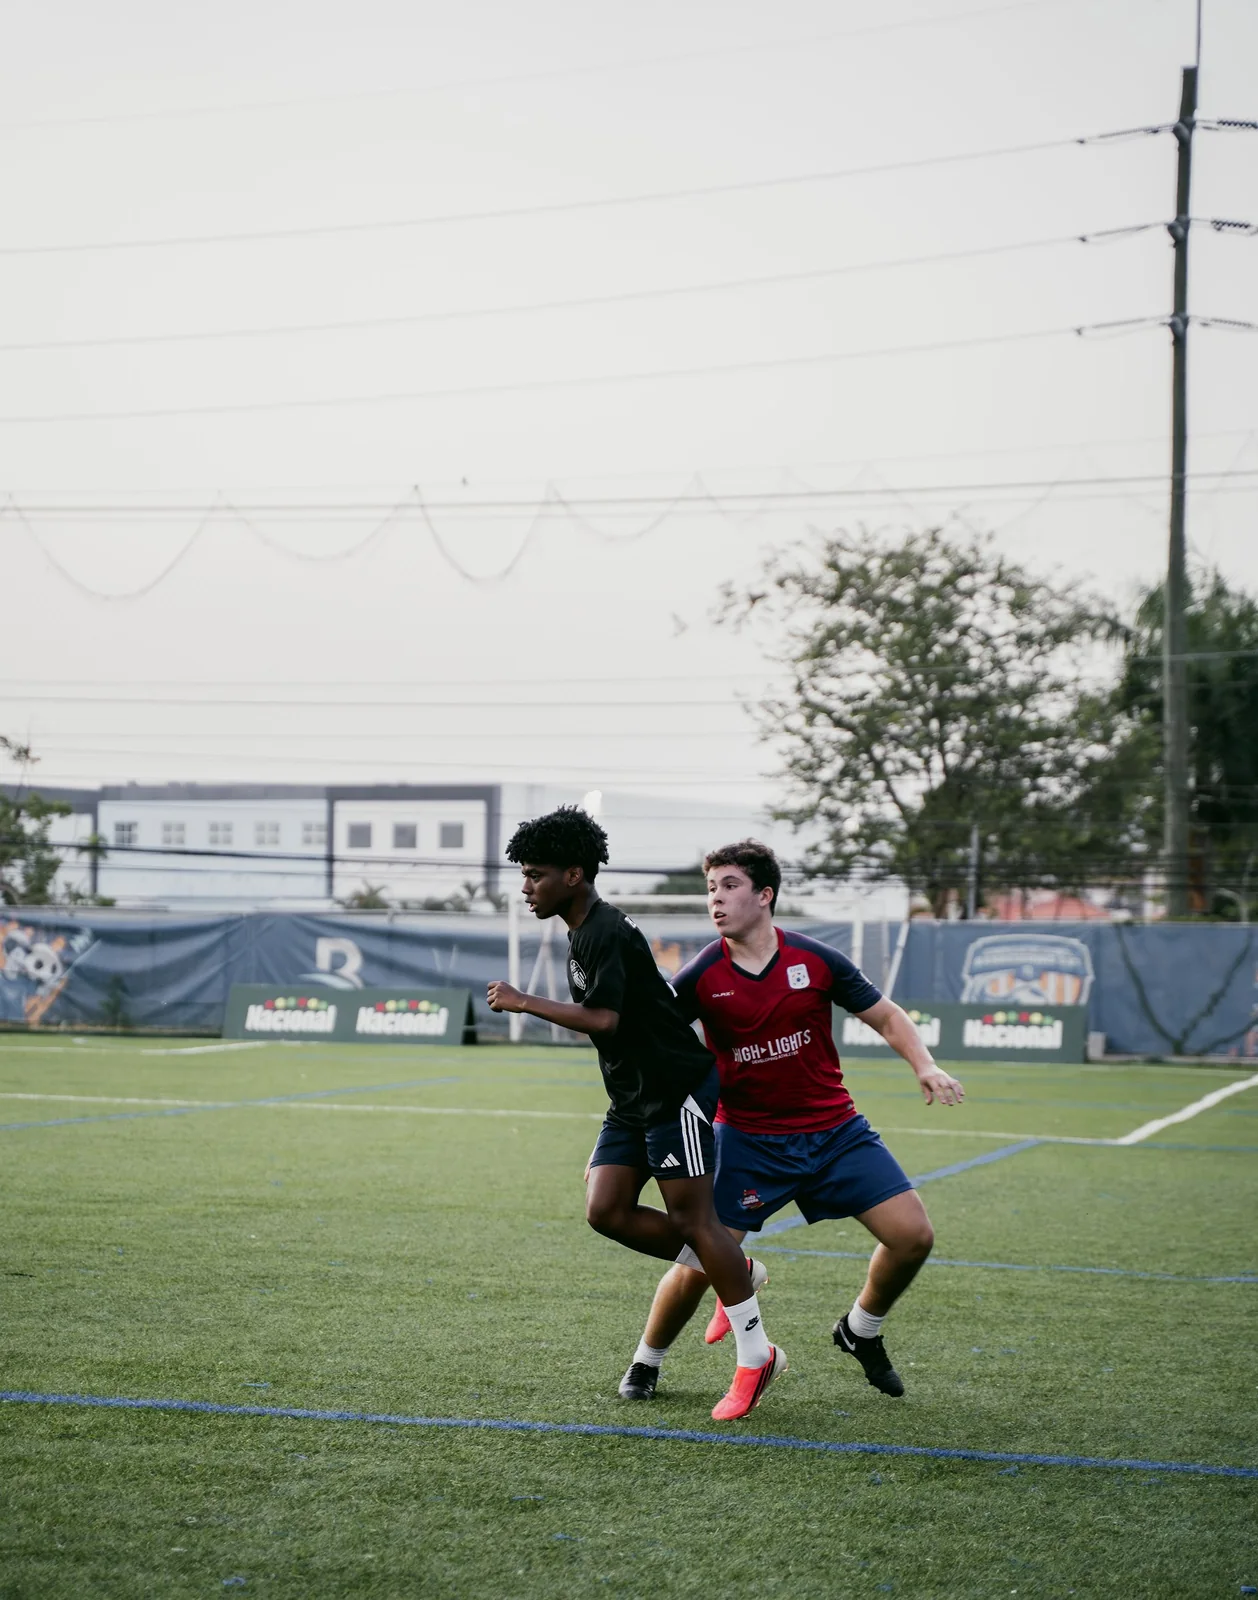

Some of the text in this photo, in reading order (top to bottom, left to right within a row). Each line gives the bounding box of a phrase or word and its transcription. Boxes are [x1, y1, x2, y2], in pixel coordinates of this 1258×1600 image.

[245, 1004, 338, 1032] Nacional
[355, 1006, 449, 1036] Nacional
[767, 1029, 812, 1056] LIGHTS
[963, 1018, 1063, 1050] Nacional
